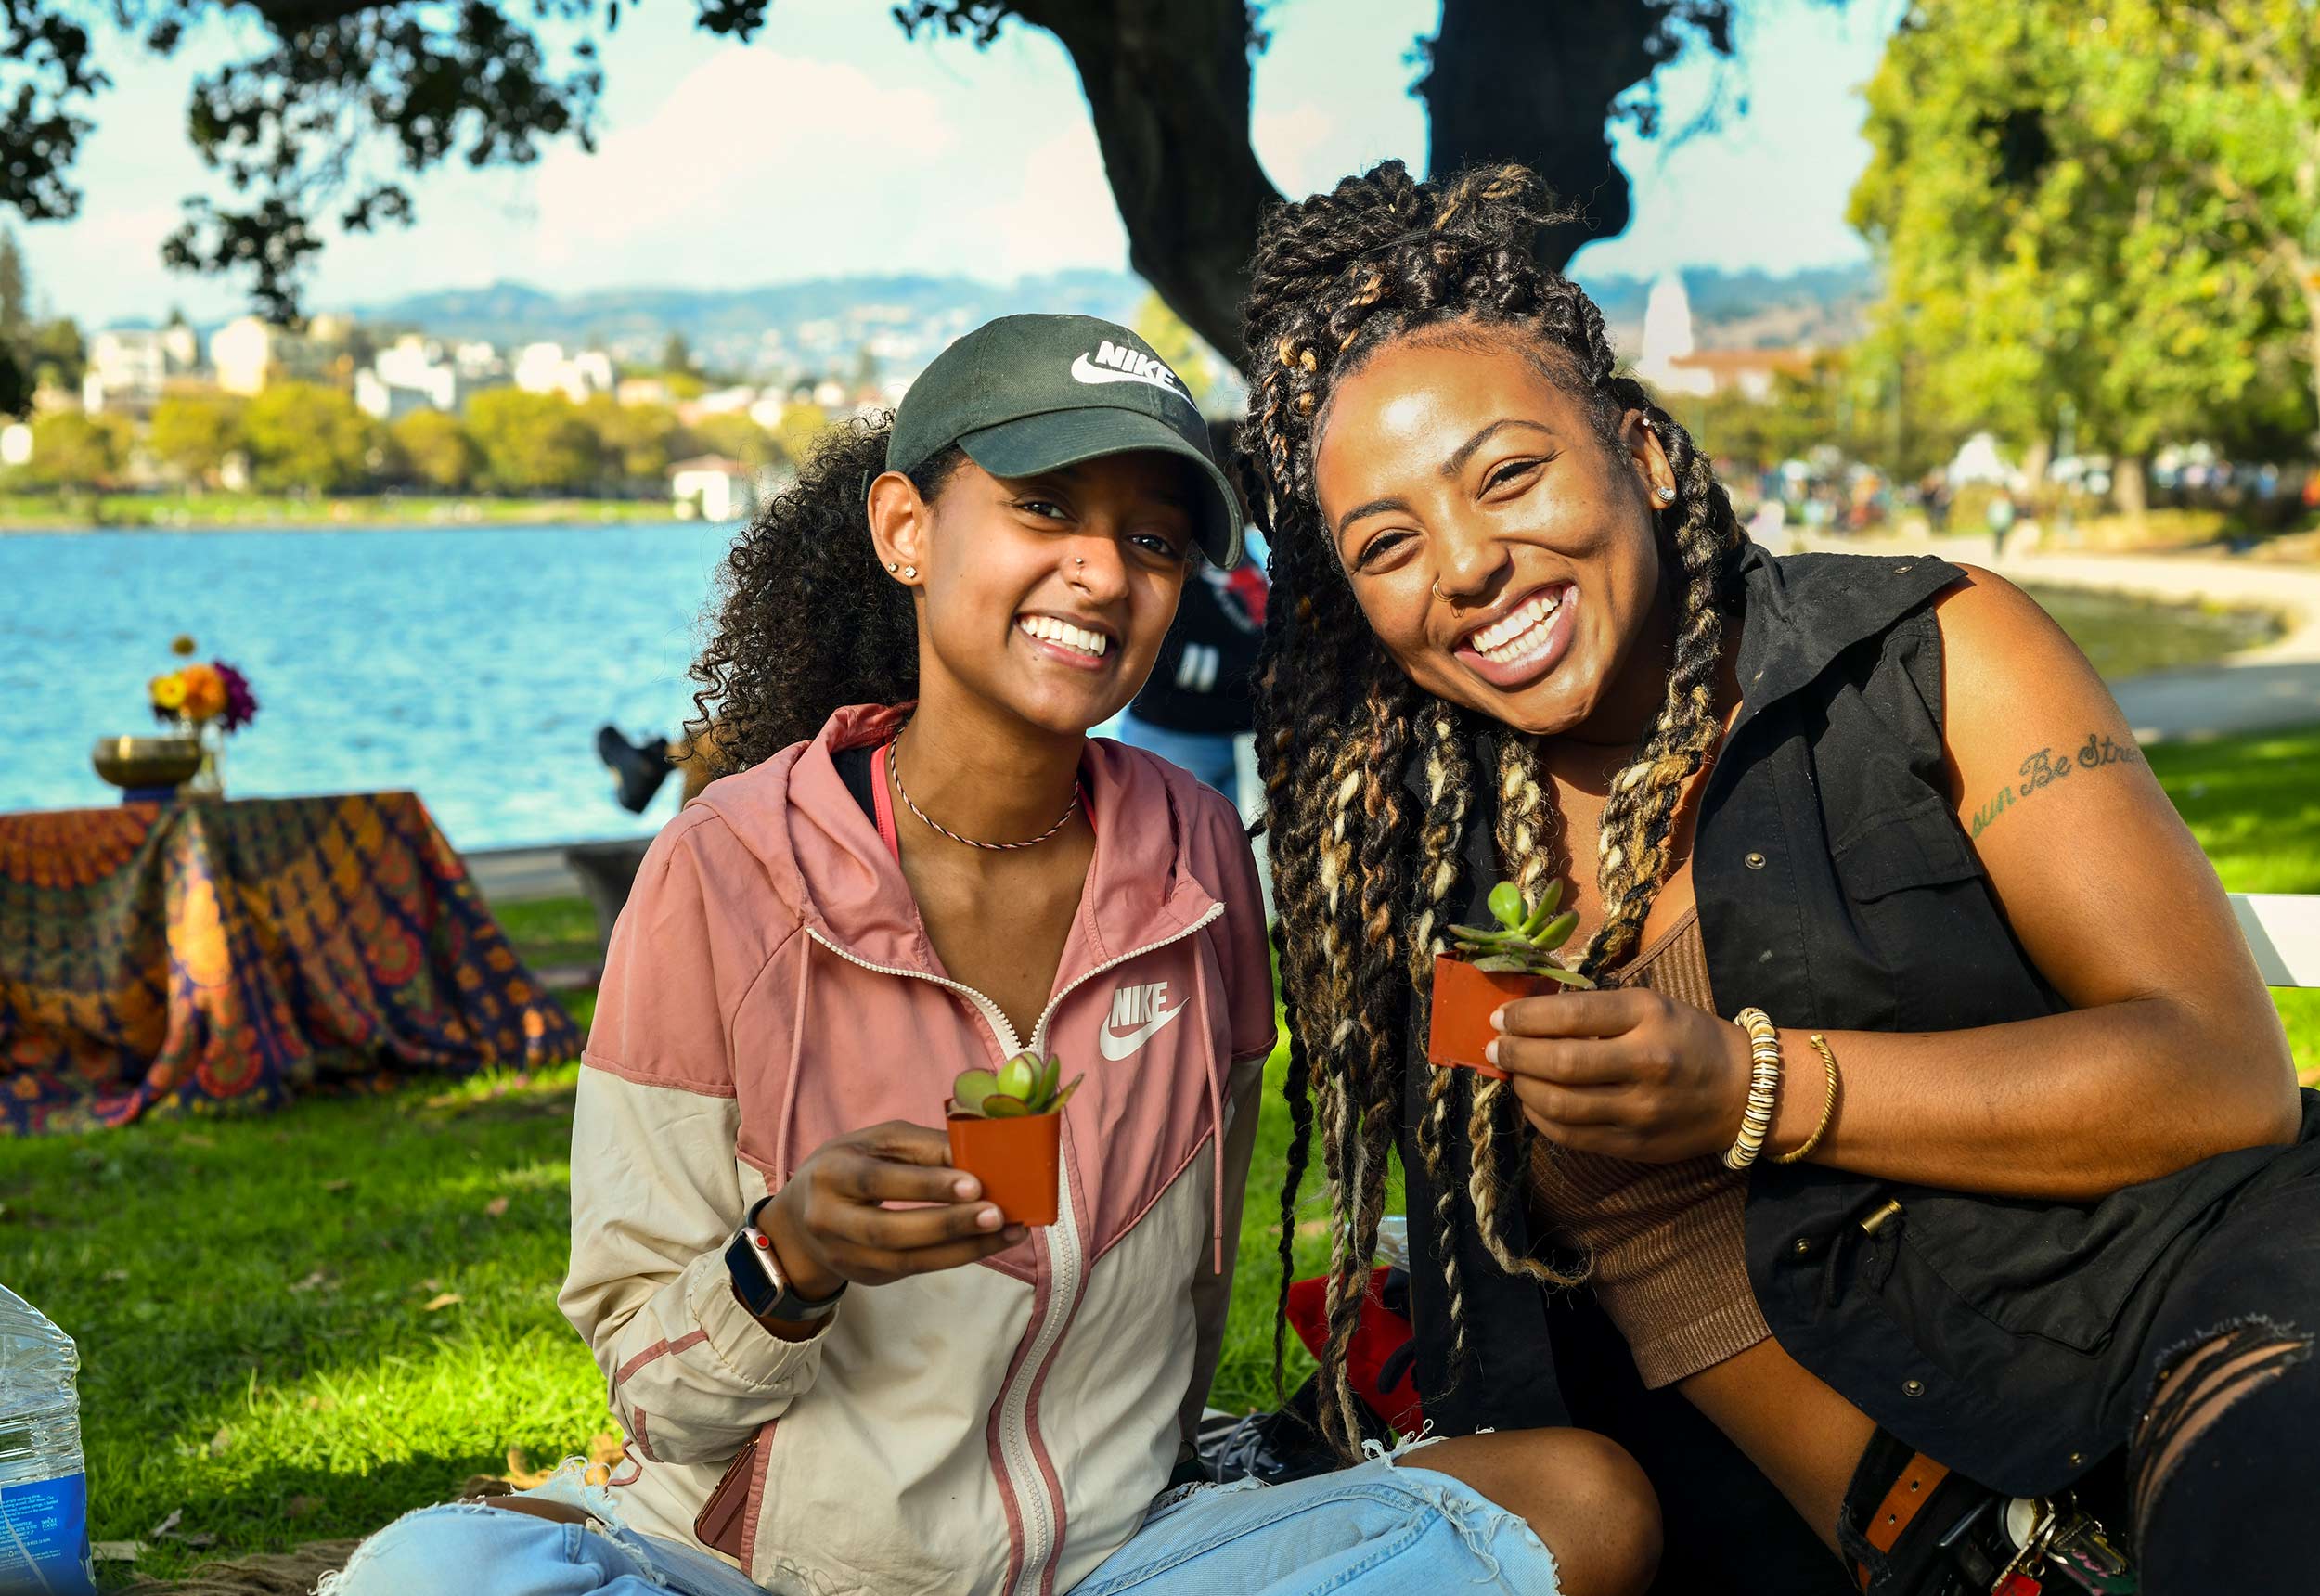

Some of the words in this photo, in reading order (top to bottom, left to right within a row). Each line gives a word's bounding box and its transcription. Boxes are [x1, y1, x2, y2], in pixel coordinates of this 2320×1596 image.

[1095, 340, 1176, 384] NIKE
[2018, 747, 2072, 797] Be
[1110, 981, 1168, 1028] NIKE
